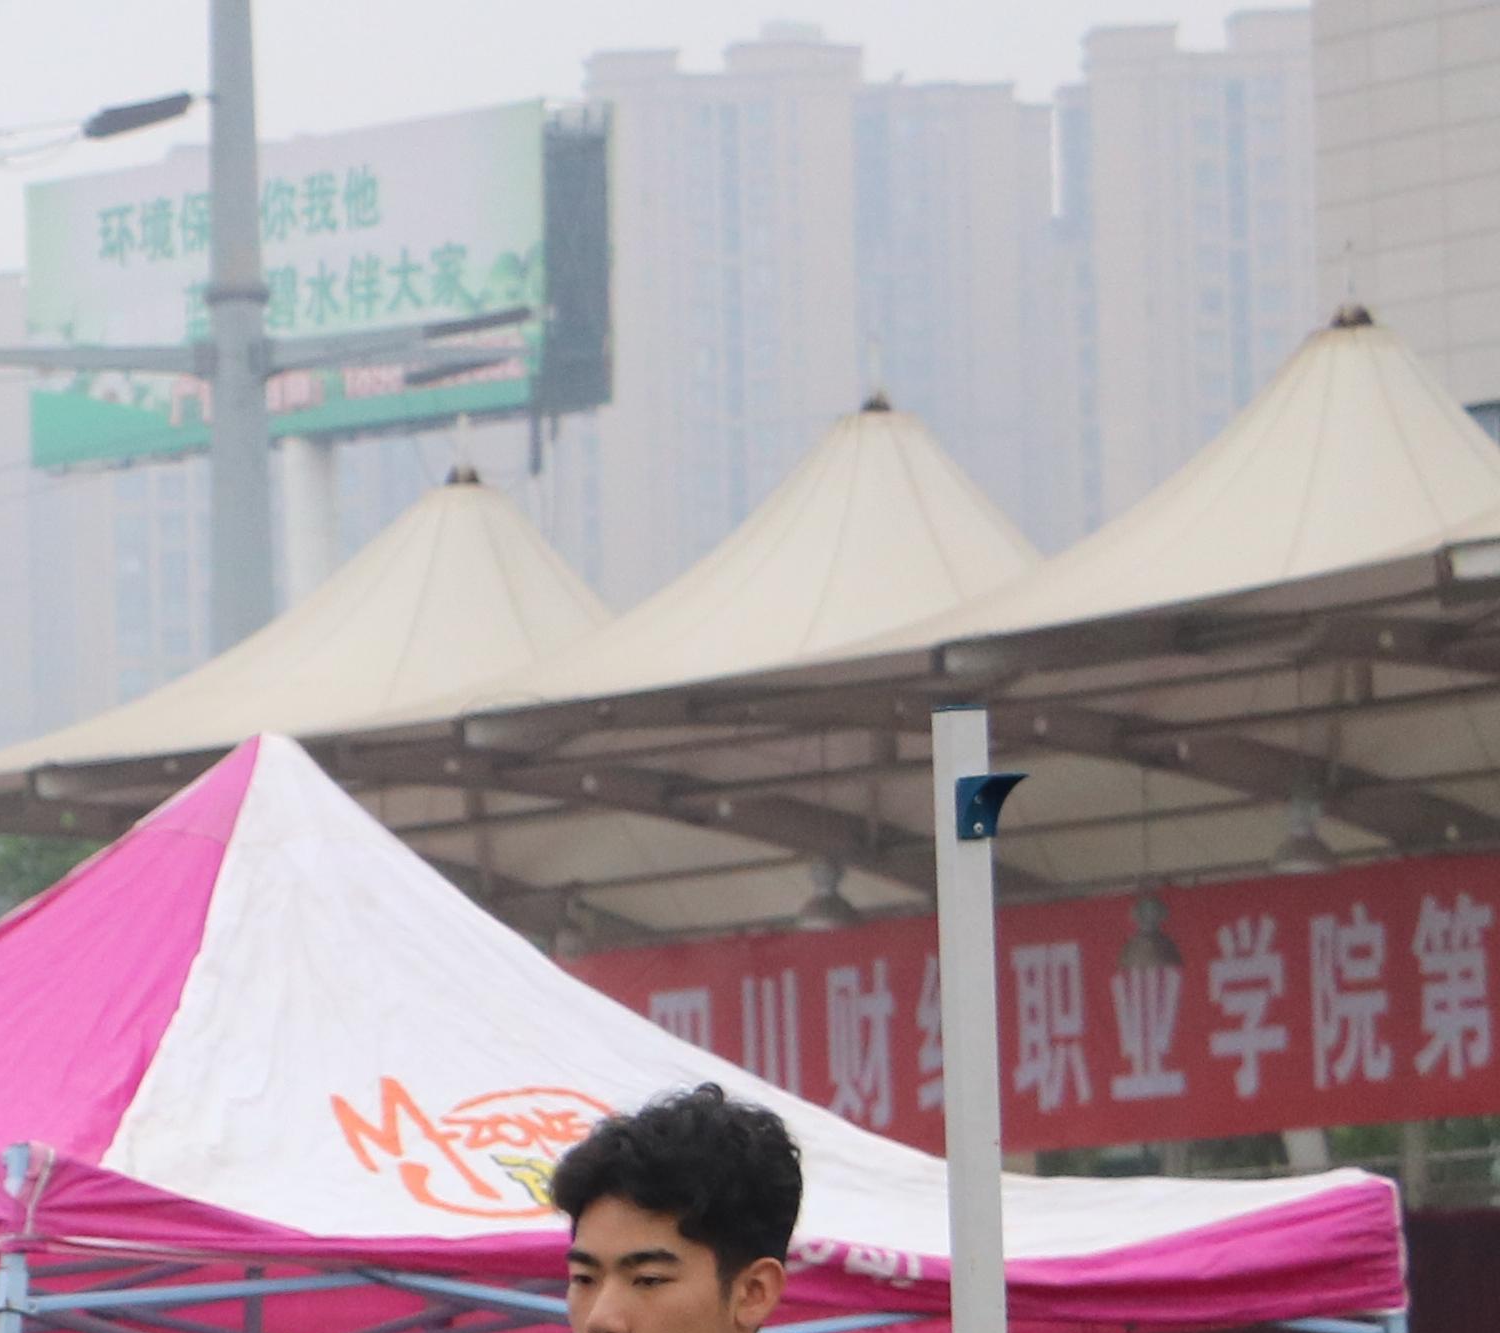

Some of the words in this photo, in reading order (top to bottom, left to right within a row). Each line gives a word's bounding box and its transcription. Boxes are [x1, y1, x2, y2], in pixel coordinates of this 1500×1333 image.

[97, 166, 380, 267] 环境保你我他
